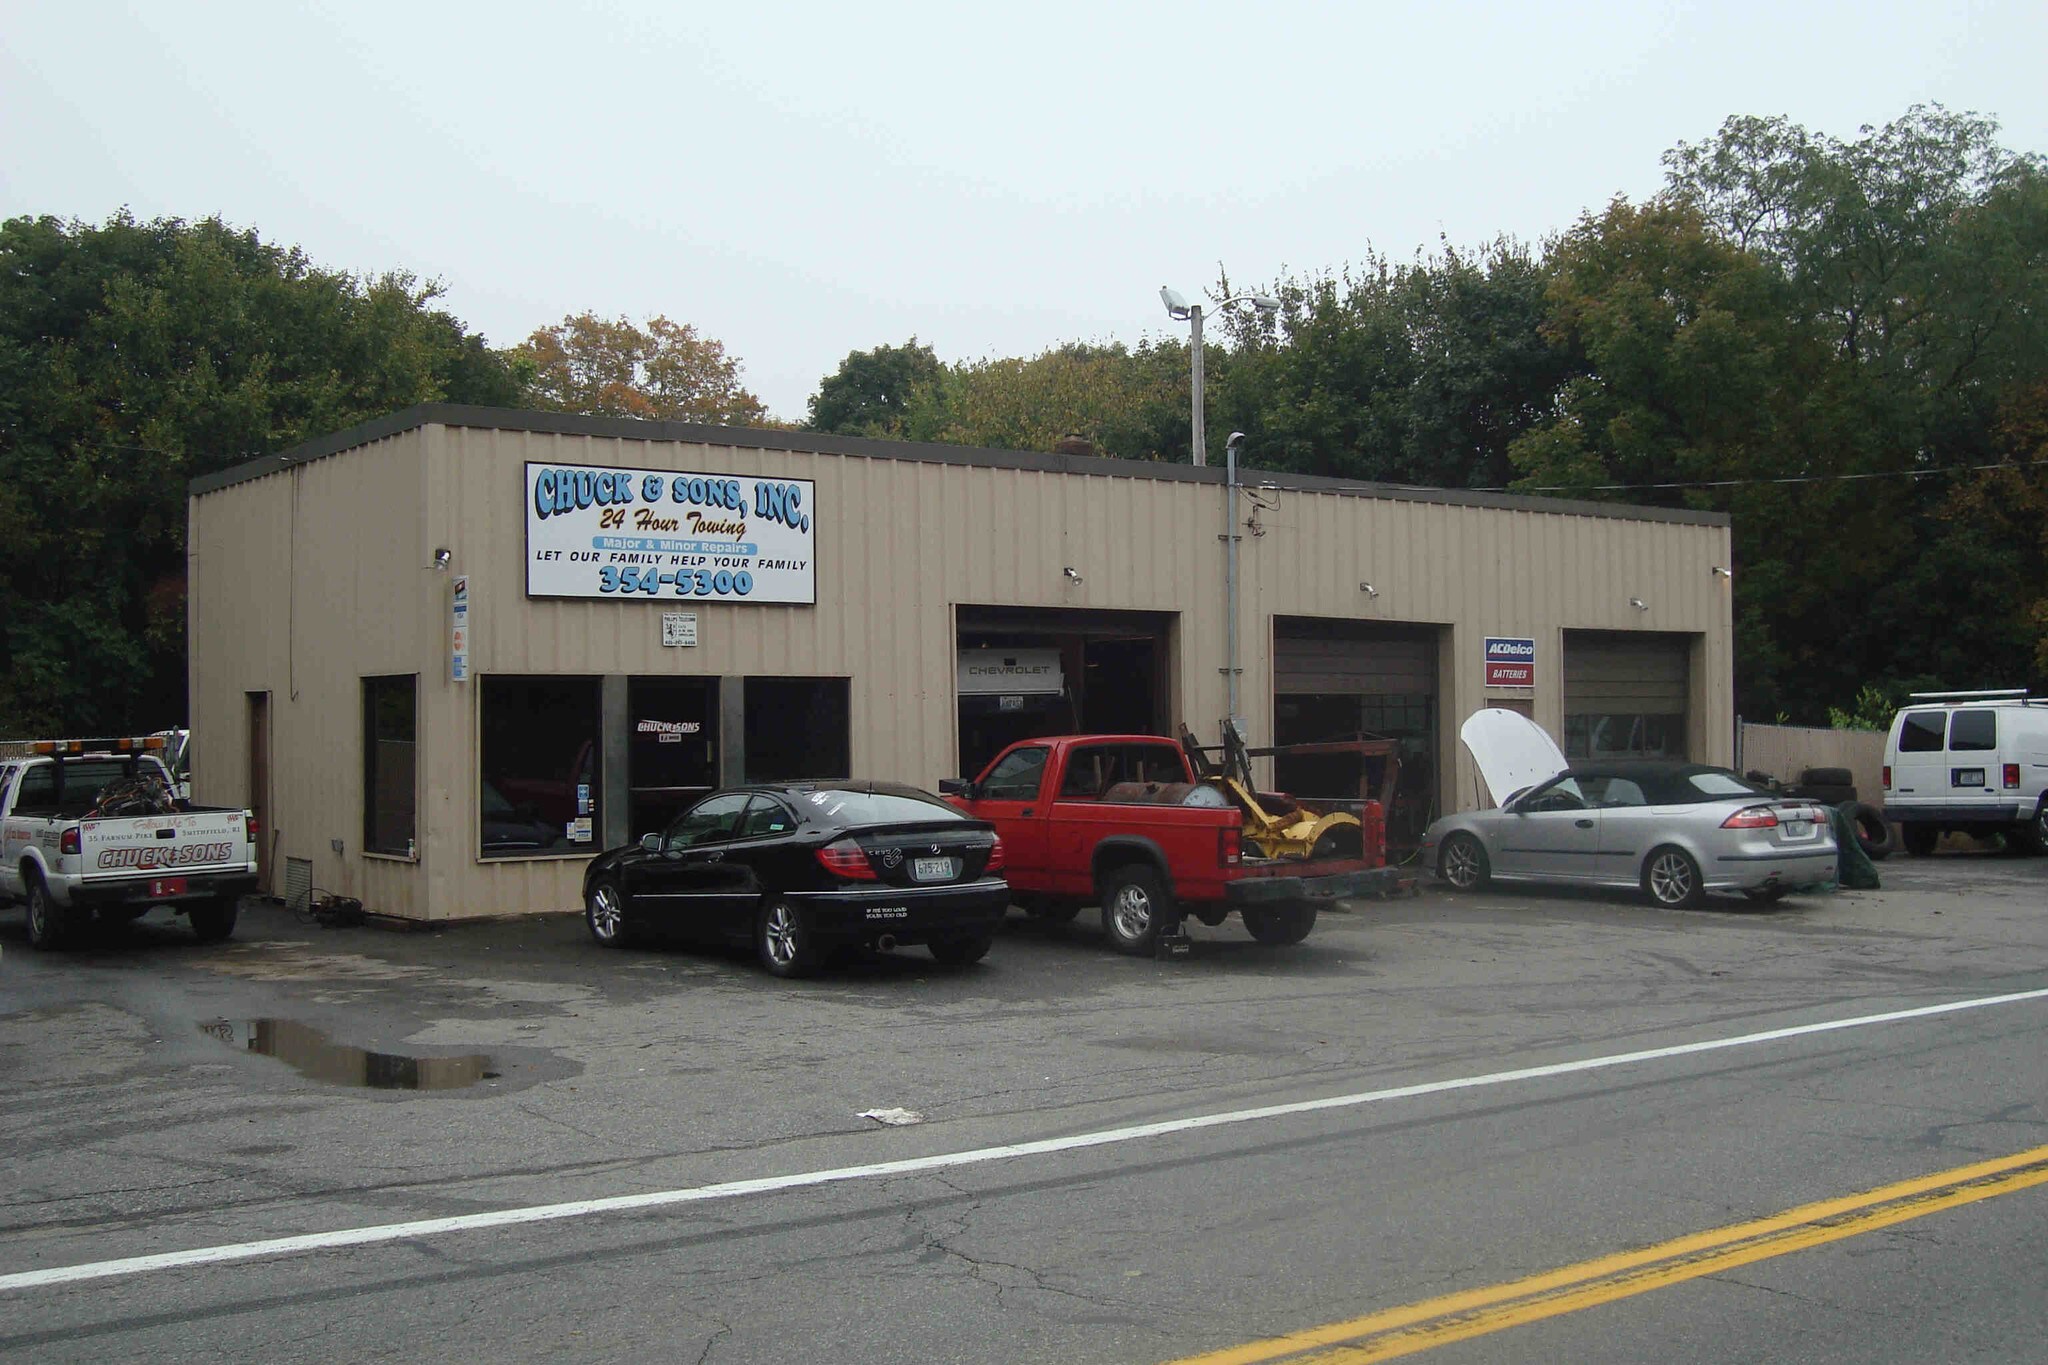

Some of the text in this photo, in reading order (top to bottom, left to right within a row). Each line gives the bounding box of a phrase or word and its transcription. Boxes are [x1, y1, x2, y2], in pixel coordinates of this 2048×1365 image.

[535, 469, 809, 534] CHUCK & SONS, INC.
[600, 508, 747, 542] 24 Hour Towing
[603, 538, 748, 554] Major & Minor Repairs
[536, 551, 807, 571] LET OUR FAMILY HELP YOUR FAMILY
[599, 565, 753, 596] 354-5300
[1488, 643, 1534, 655] ACDelco
[968, 666, 1050, 675] CHEVROLET
[1492, 669, 1528, 679] BATTERIES
[676, 722, 700, 732] SONS
[98, 847, 169, 868] CHUCK
[179, 842, 233, 864] SONS
